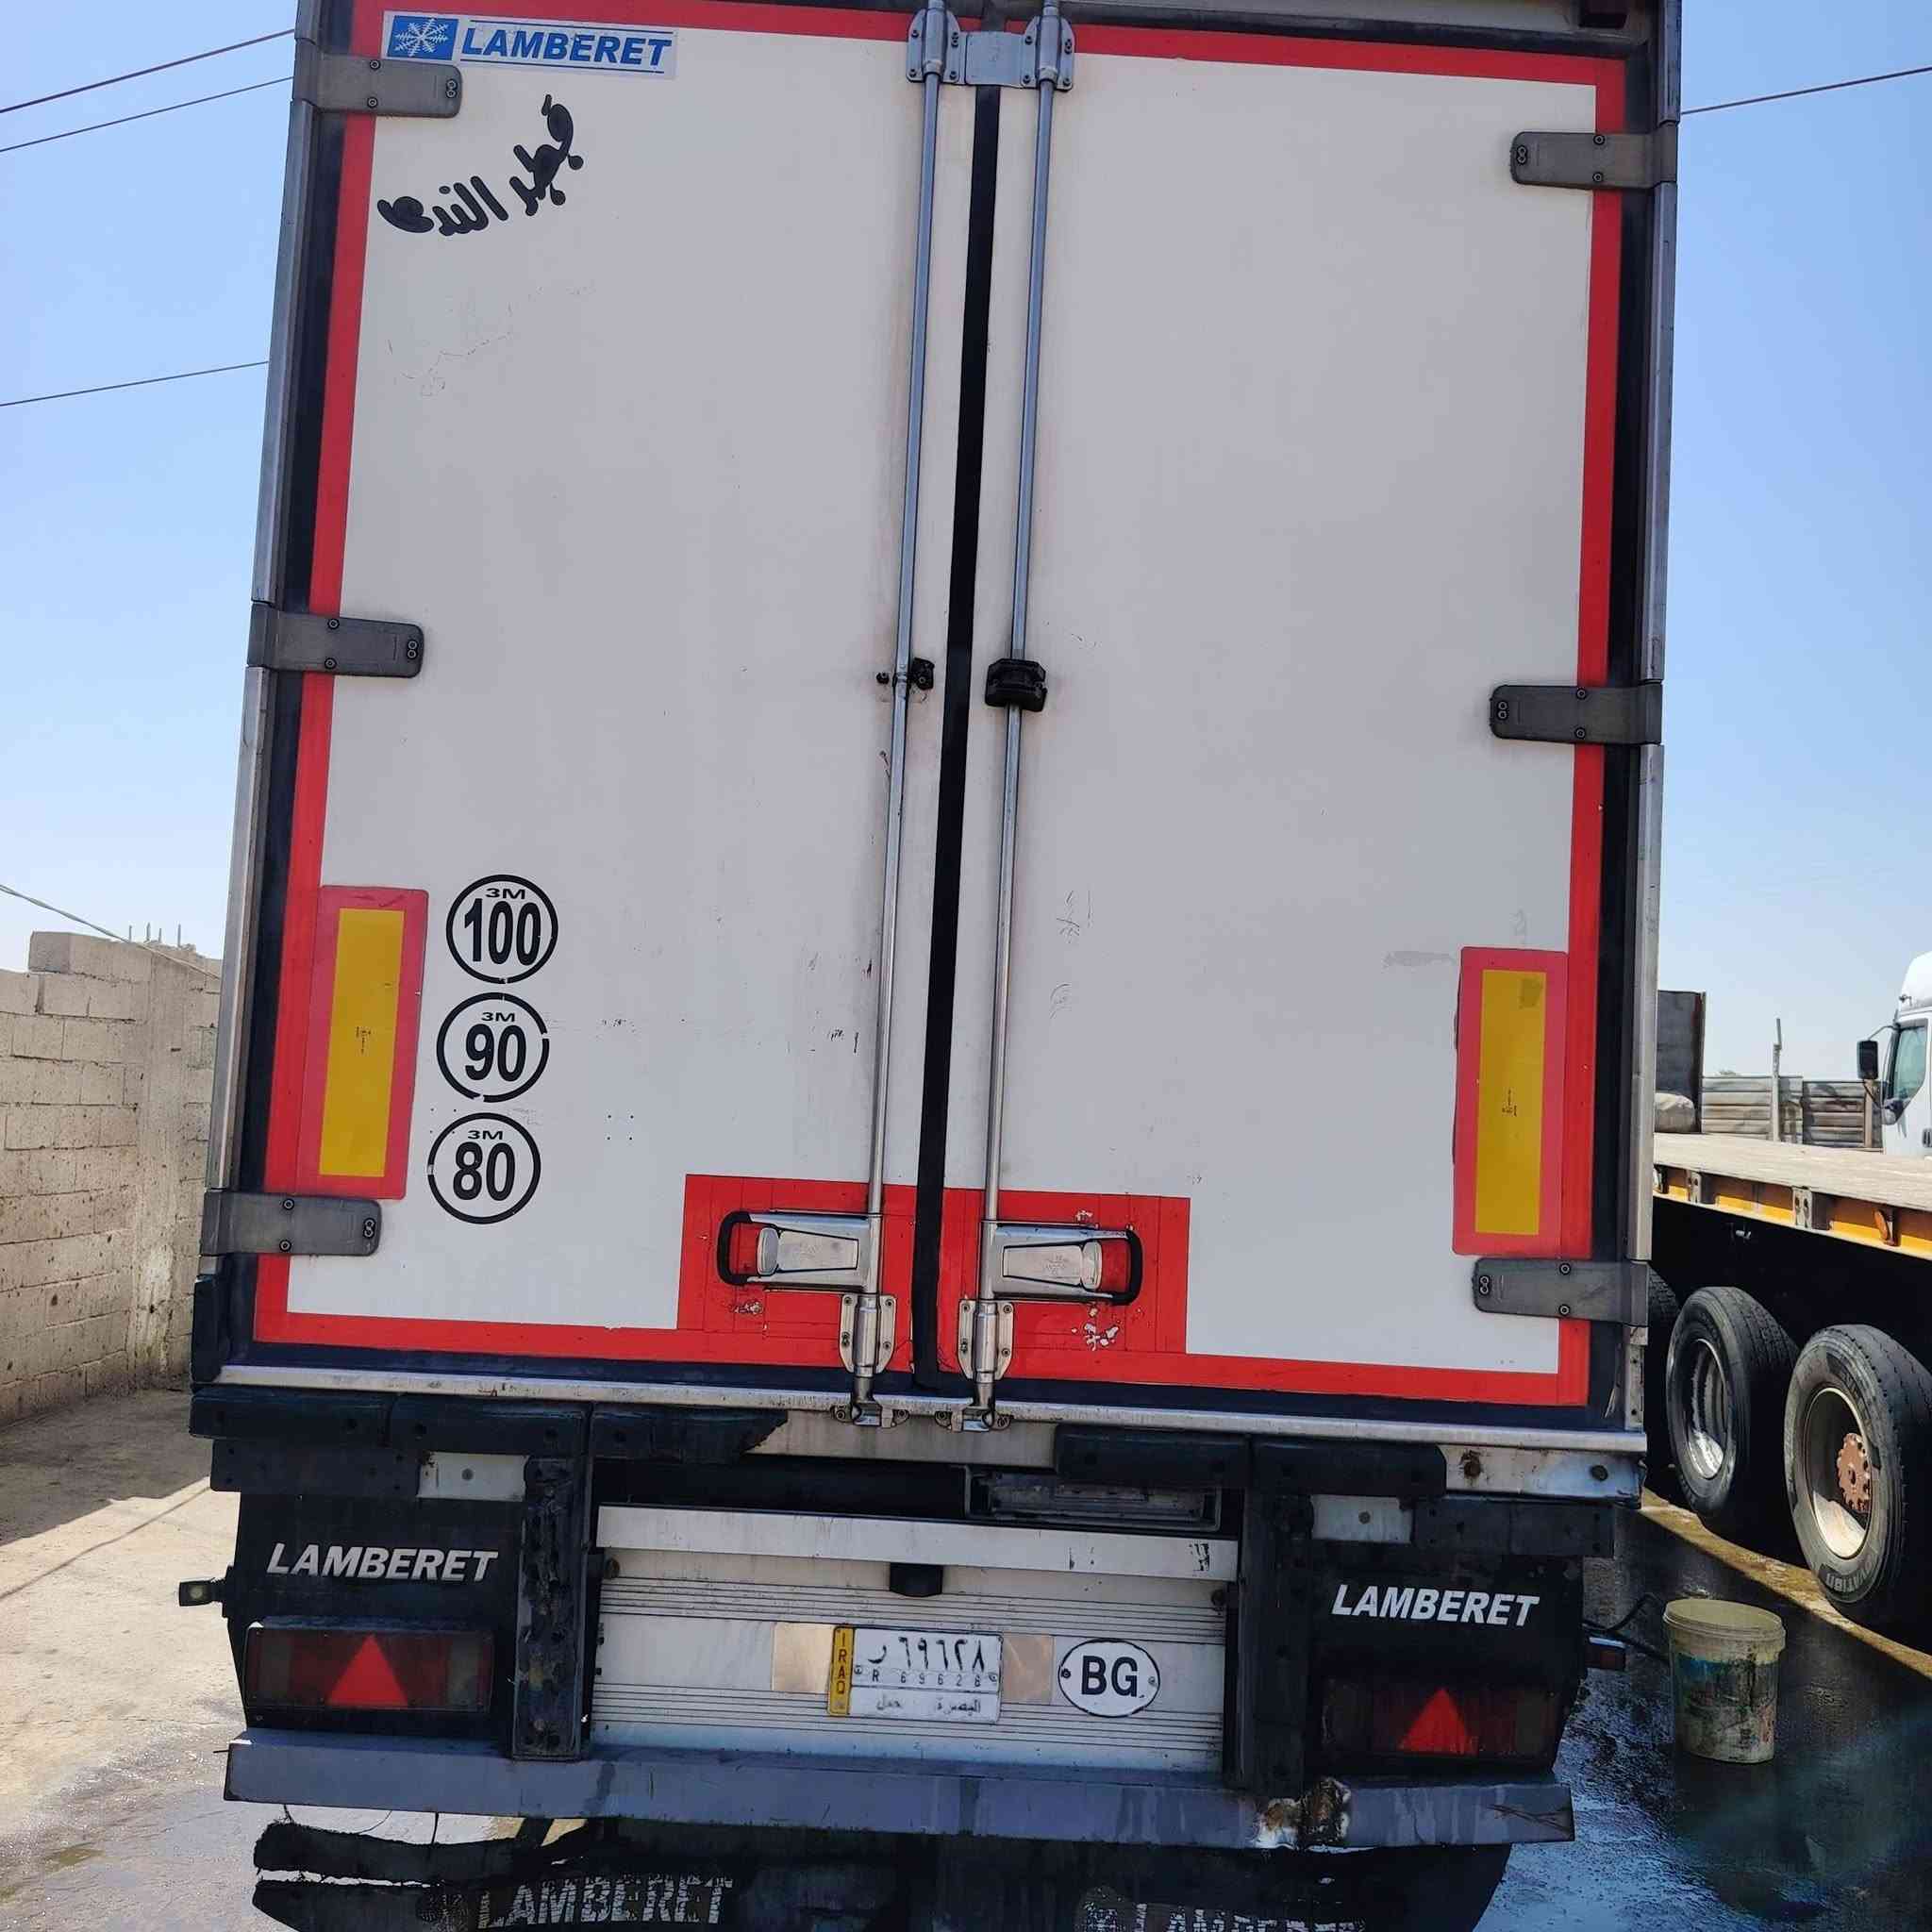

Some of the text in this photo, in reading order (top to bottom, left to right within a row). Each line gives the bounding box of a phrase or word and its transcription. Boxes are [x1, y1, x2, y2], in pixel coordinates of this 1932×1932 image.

[461, 27, 673, 67] LAMBERET
[485, 888, 525, 900] 3M
[463, 897, 541, 967] 100
[481, 1011, 516, 1023] 3M
[464, 1024, 527, 1082] 90
[467, 1129, 504, 1141] 3M
[452, 1141, 516, 1202] 80
[266, 1542, 499, 1582] LAMBERET
[1331, 1584, 1541, 1626] LAMBERET
[1081, 1655, 1139, 1697] BG
[476, 1873, 734, 1930] LAMBERET
